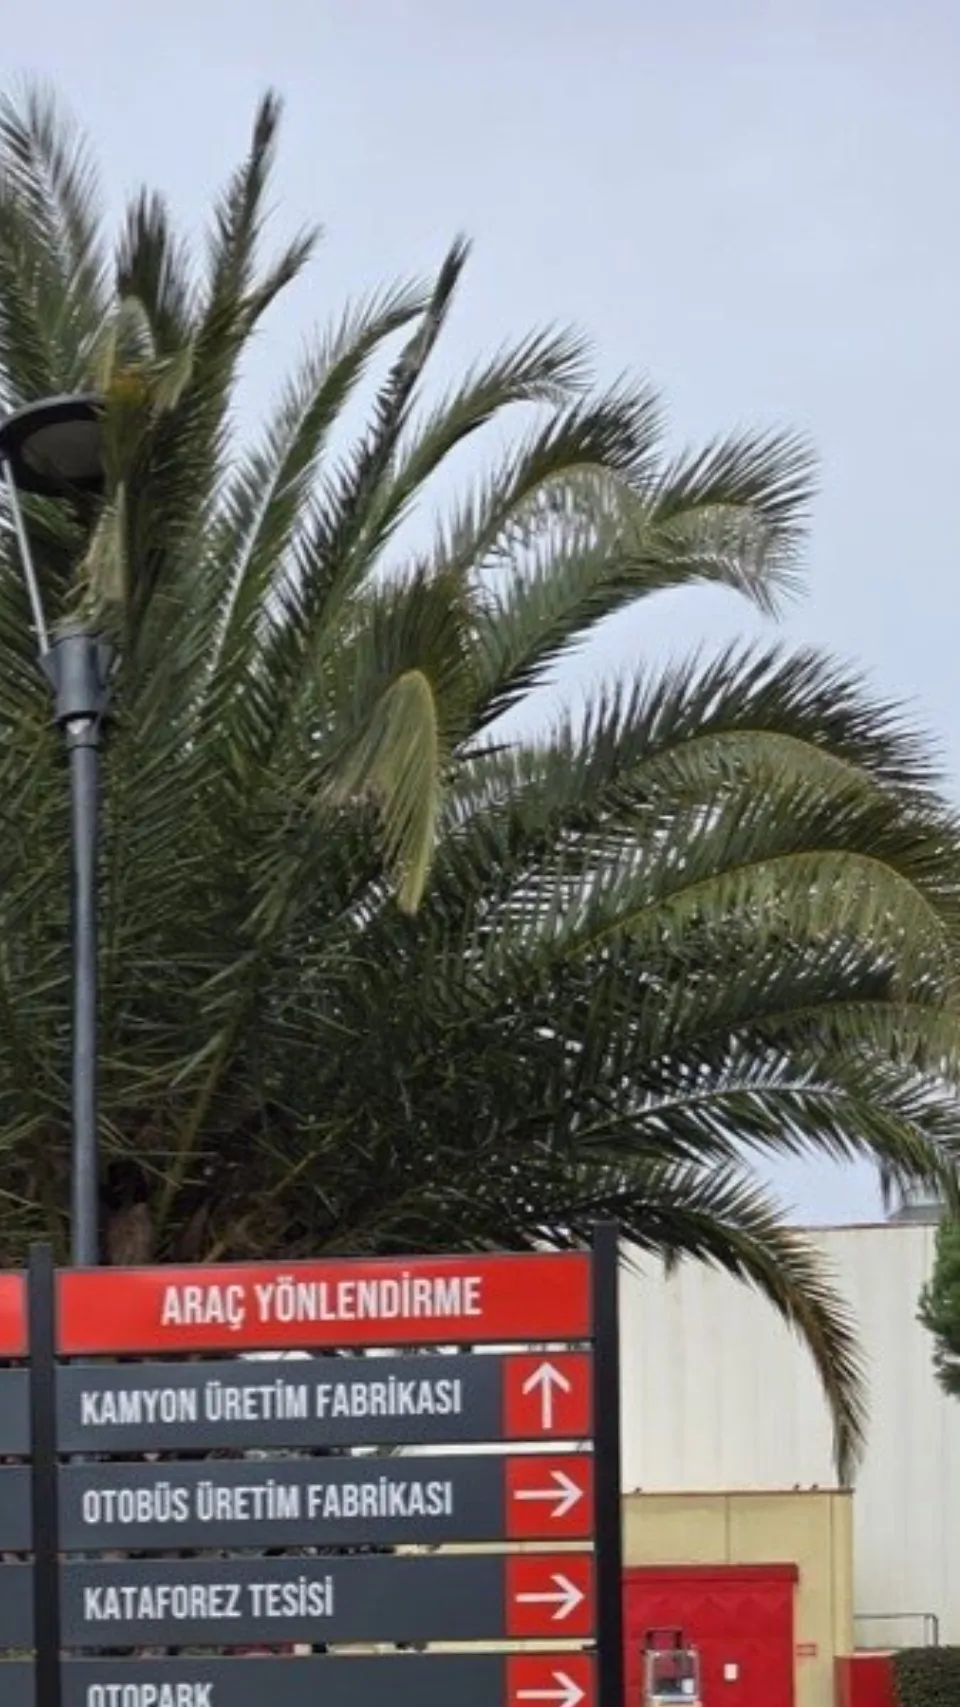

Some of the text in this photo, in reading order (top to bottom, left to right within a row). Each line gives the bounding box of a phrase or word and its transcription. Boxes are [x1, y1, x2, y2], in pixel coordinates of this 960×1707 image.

[161, 1271, 482, 1331] ARAÇ YÖNLENDİRME
[80, 1375, 461, 1425] KAMYON ÜRETİM FABRİKASI
[82, 1475, 453, 1524] OTOBÜS ÜRETİM FABRİKASI
[84, 1575, 333, 1621] KATAFOREZ TESİSİ
